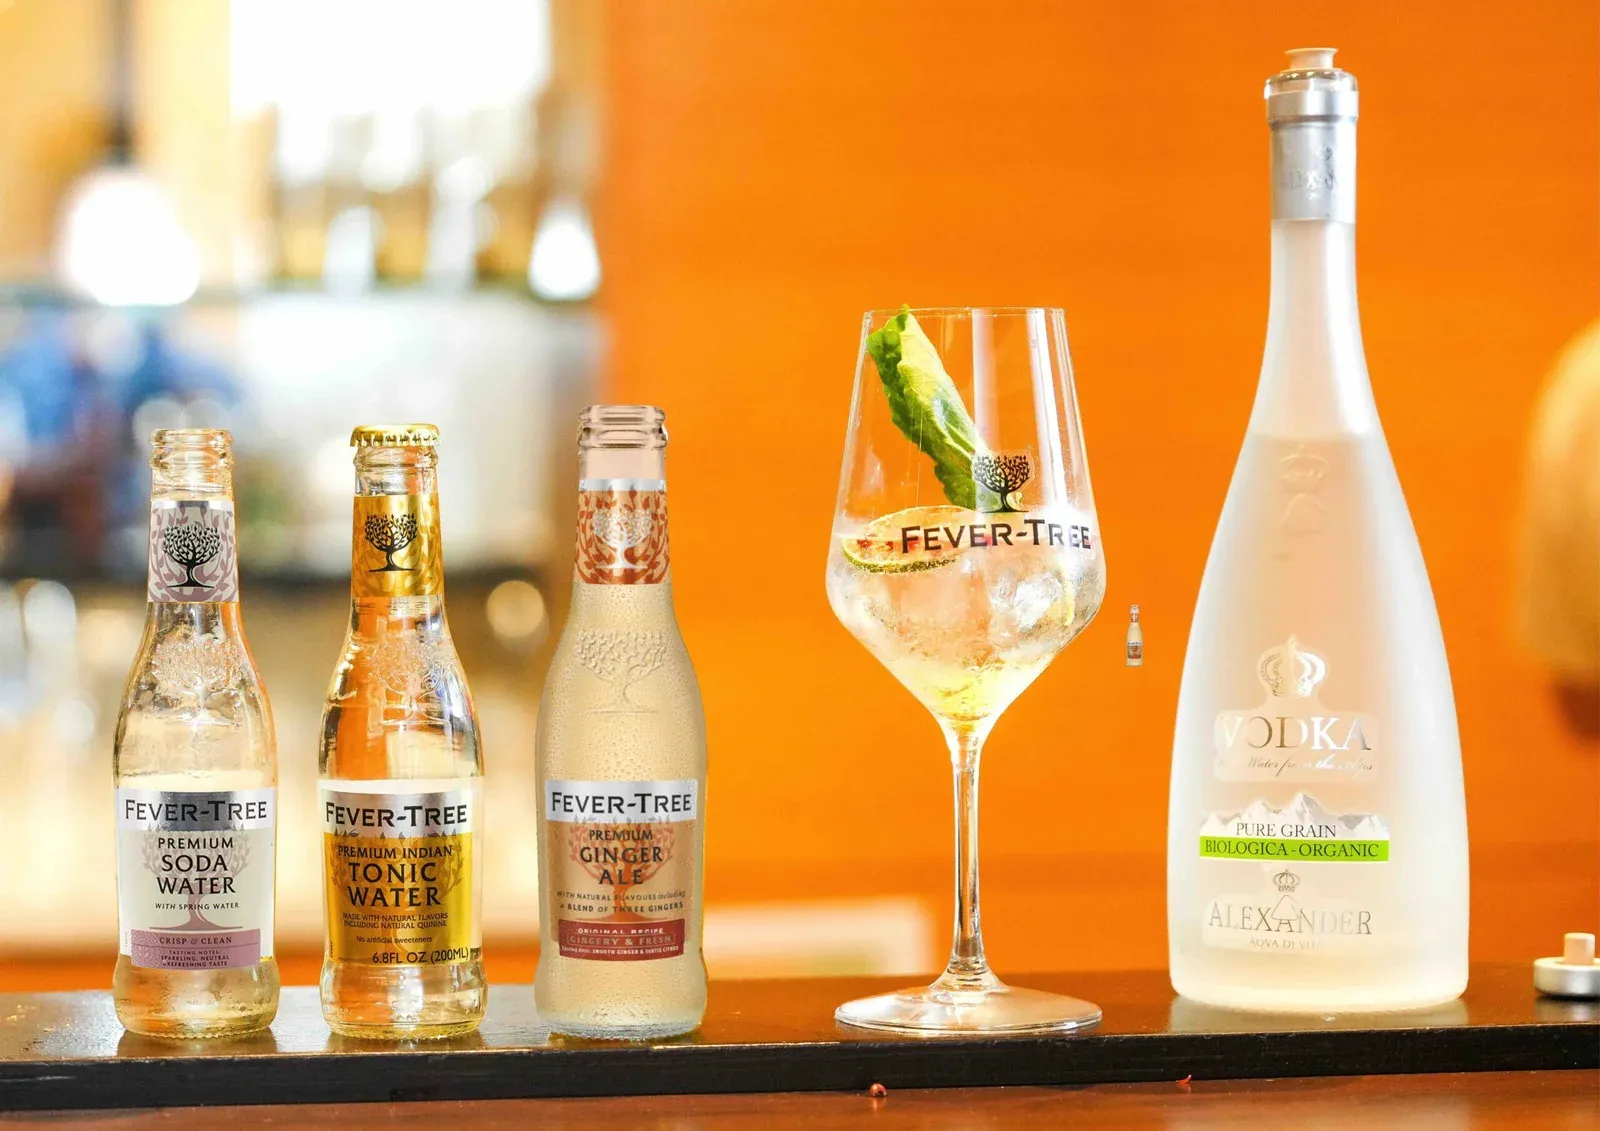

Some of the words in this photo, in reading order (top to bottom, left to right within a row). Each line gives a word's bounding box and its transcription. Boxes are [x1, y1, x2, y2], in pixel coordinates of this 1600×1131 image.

[901, 518, 1092, 554] FEVER-TREE
[1220, 716, 1372, 751] VODKA
[125, 799, 267, 822] FEVER-TREE
[552, 791, 692, 814] FEVER-TREE
[325, 801, 467, 828] FEVER-TREE
[589, 829, 653, 841] PREMIUM
[1236, 822, 1276, 837] PURE
[1280, 824, 1337, 839] GRAIN
[158, 837, 234, 850] PREMIUM
[338, 845, 397, 859] PREMIUM
[403, 845, 453, 859] INDIAN
[580, 846, 663, 863] GINGER
[161, 854, 228, 873] SODA
[348, 862, 437, 884] TONIC
[598, 869, 644, 885] ALE
[156, 876, 237, 895] WATER
[347, 886, 441, 907] WATER
[577, 893, 612, 901] NATURAL
[614, 893, 656, 901] FLAVOURS
[155, 902, 176, 910] WITH
[178, 903, 210, 911] SPRING
[213, 902, 239, 910] WATER
[568, 903, 594, 912] BLEND
[613, 905, 645, 913] THREE
[648, 901, 684, 912] GINGERS
[1208, 895, 1373, 935] ALEXANDER
[343, 912, 360, 920] MADE
[362, 913, 380, 921] WITH
[381, 914, 417, 922] NATURAL
[418, 912, 449, 921] FLAVORS
[344, 919, 379, 929] INCLUDING
[380, 921, 415, 929] NATURAL
[417, 919, 447, 930] QUININE
[160, 936, 187, 945] CRISP
[200, 936, 232, 945] CLEAN
[356, 935, 366, 943] No
[366, 935, 393, 944] artificial
[394, 936, 433, 944] sweeteners
[570, 935, 619, 946] GINGERY
[624, 938, 633, 946] &
[639, 935, 672, 946] FRESH
[407, 952, 427, 963] OZ
[430, 947, 469, 964] (200ML)
